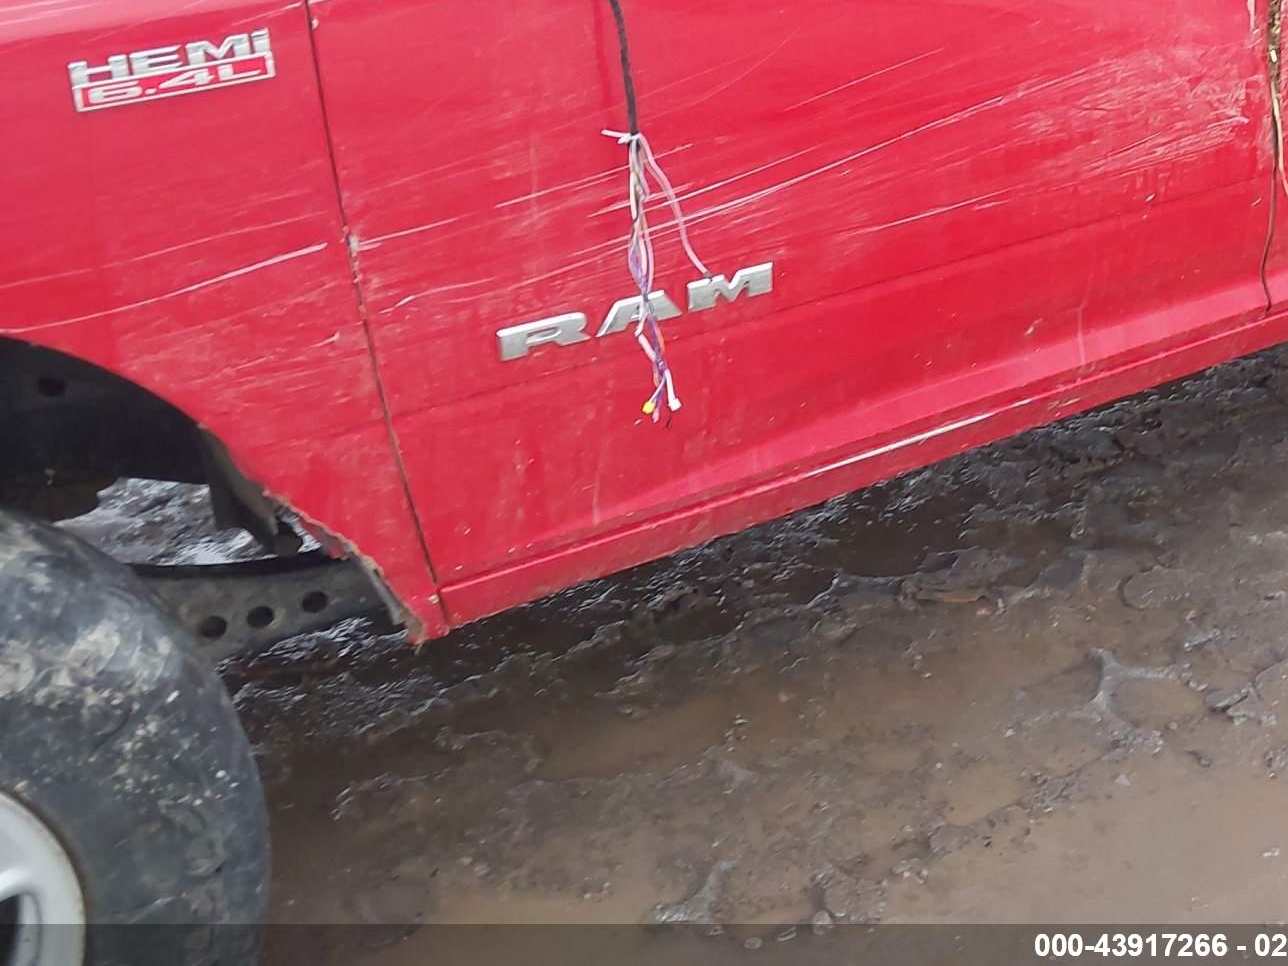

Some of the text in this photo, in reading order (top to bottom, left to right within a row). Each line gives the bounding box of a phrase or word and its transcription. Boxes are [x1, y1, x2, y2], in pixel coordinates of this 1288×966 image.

[67, 27, 270, 89] HEMI
[87, 64, 262, 104] 6.4L
[496, 261, 774, 362] RAM
